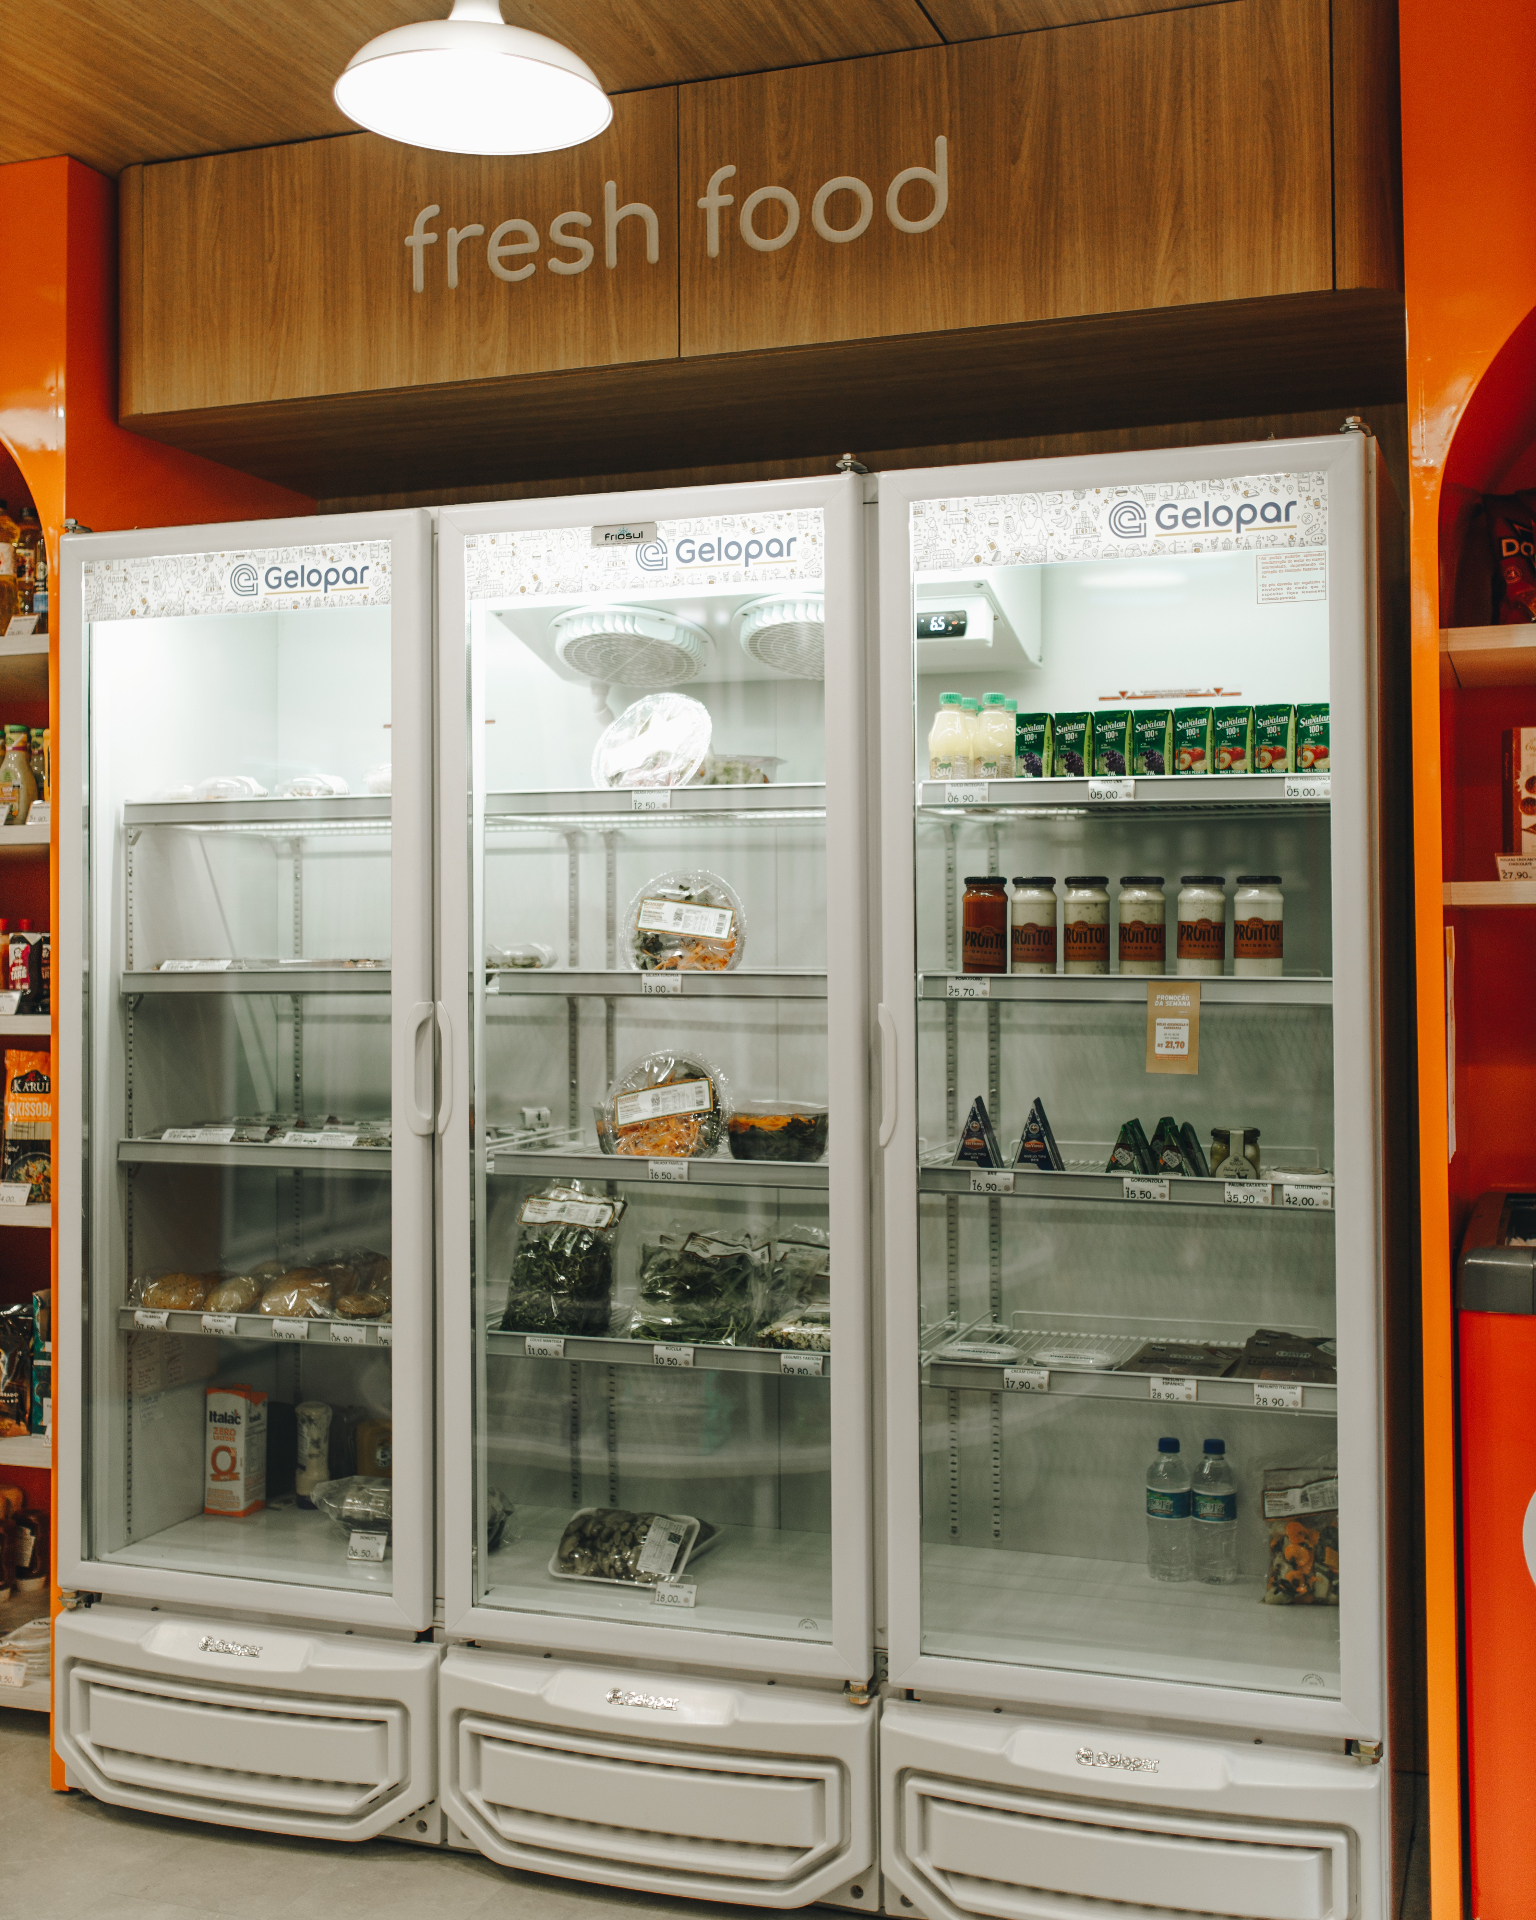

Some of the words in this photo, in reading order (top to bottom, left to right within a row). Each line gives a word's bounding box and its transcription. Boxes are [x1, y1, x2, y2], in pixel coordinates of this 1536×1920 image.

[404, 179, 660, 293] fresh
[697, 135, 949, 258] food
[1154, 500, 1298, 534] Gelopar
[675, 536, 797, 567] Gelopar
[264, 564, 370, 593] Gelopar
[1165, 1041, 1185, 1049] 21,70
[1227, 1195, 1255, 1204] 35,90
[1285, 1197, 1315, 1207] 42,00
[1005, 1380, 1031, 1390] 17,90
[208, 1408, 242, 1425] Italac
[213, 1426, 237, 1436] ZERO
[1096, 1751, 1160, 1772] Gelopar
